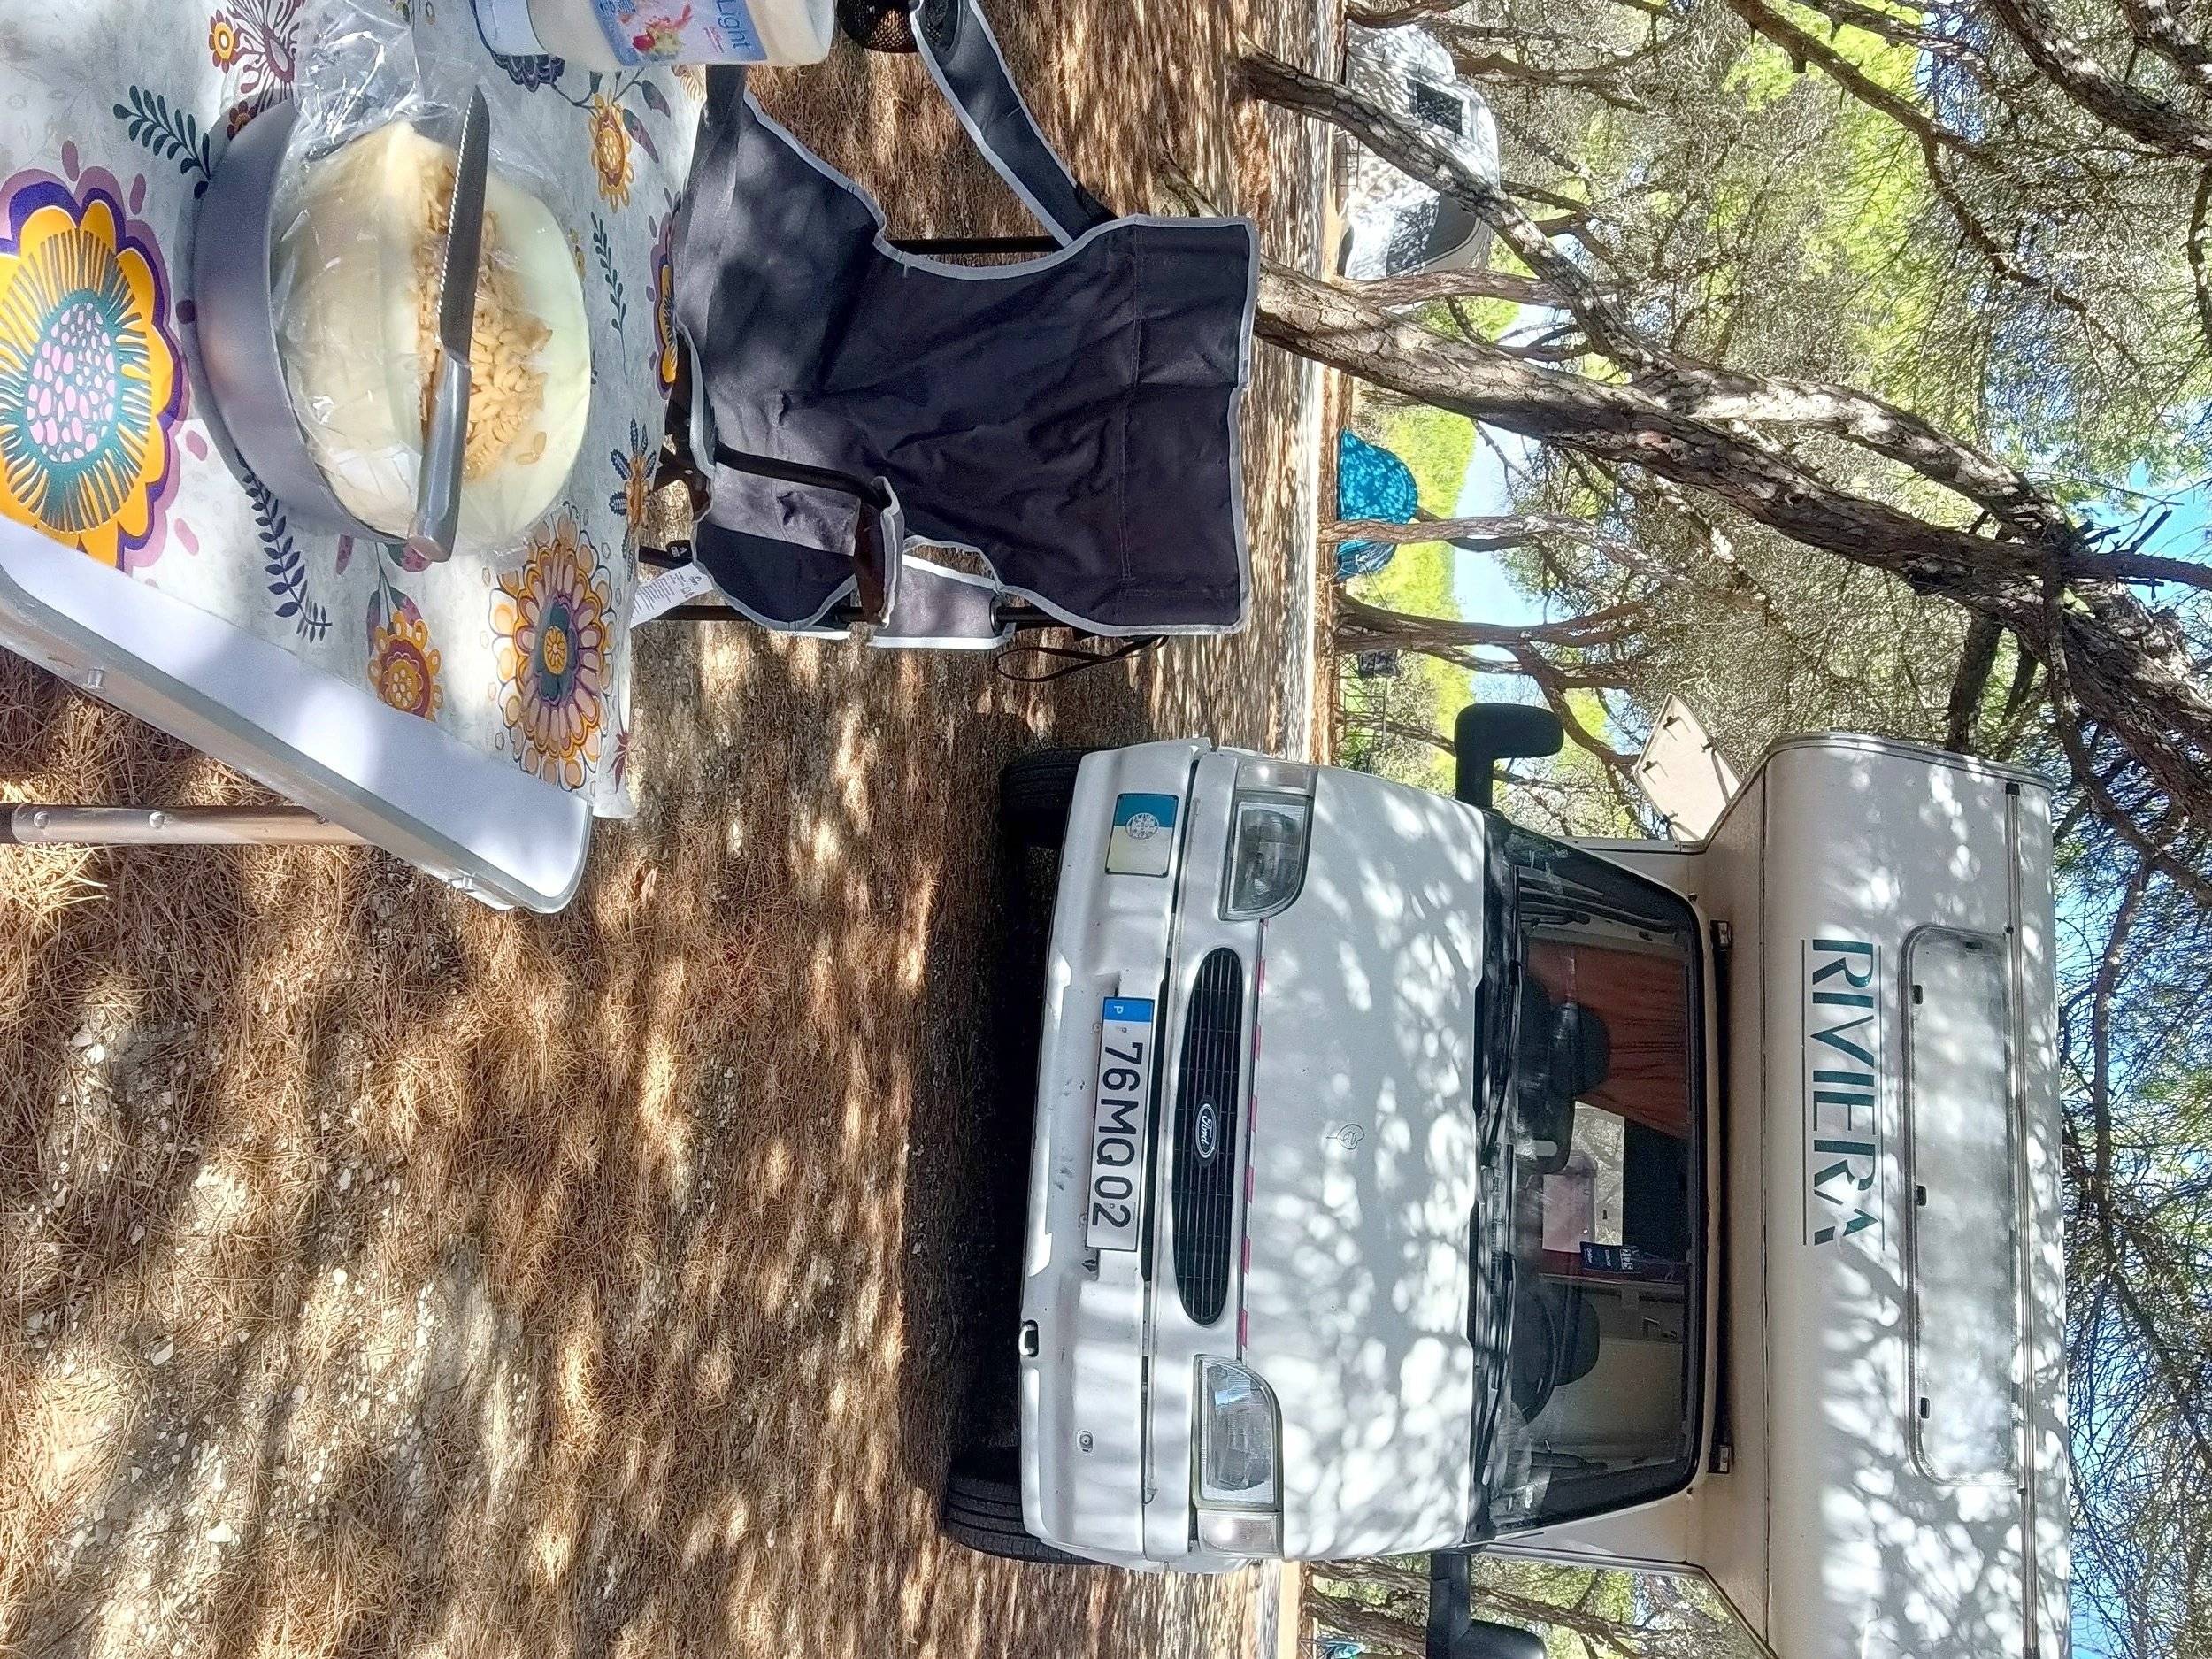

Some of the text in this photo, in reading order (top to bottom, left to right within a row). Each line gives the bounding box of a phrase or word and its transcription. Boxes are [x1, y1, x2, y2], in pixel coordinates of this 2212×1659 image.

[717, 0, 750, 49] Light
[1113, 1005, 1124, 1015] P
[1810, 939, 1878, 1246] RIVIERA
[1201, 1116, 1213, 1145] Ford
